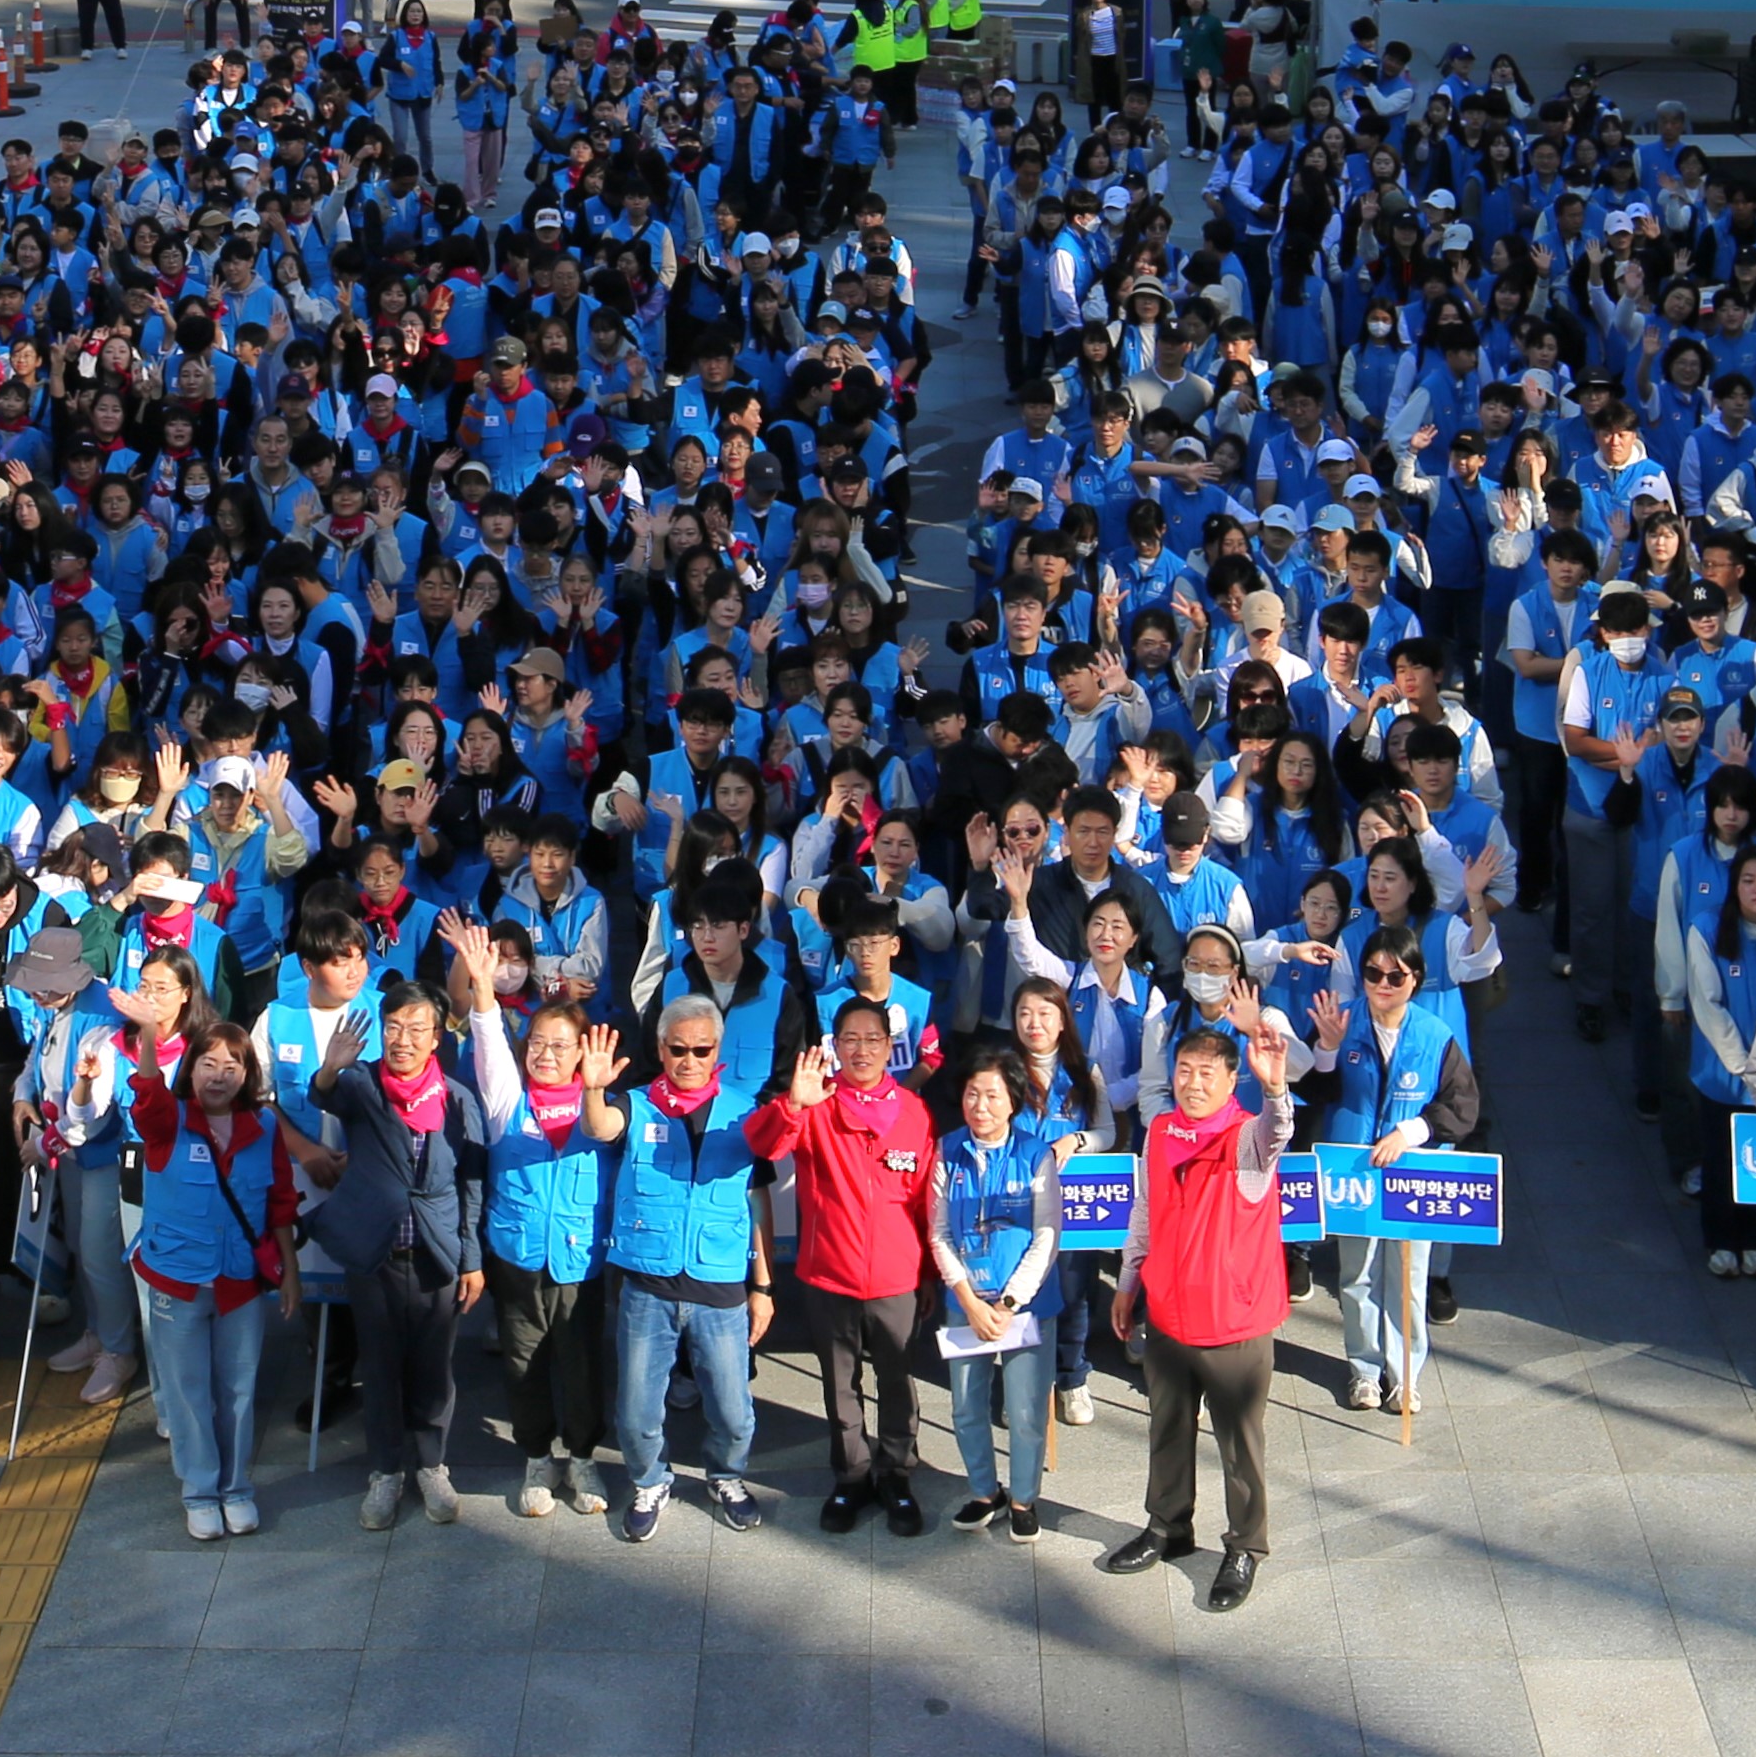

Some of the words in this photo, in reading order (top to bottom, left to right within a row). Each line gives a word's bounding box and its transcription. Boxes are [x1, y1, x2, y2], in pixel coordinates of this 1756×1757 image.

[406, 1082, 444, 1113] UNPM
[1325, 1176, 1373, 1206] UN
[1385, 1178, 1493, 1201] UN평화봉사단
[1063, 1206, 1091, 1221] 1조
[1425, 1200, 1453, 1217] 3조
